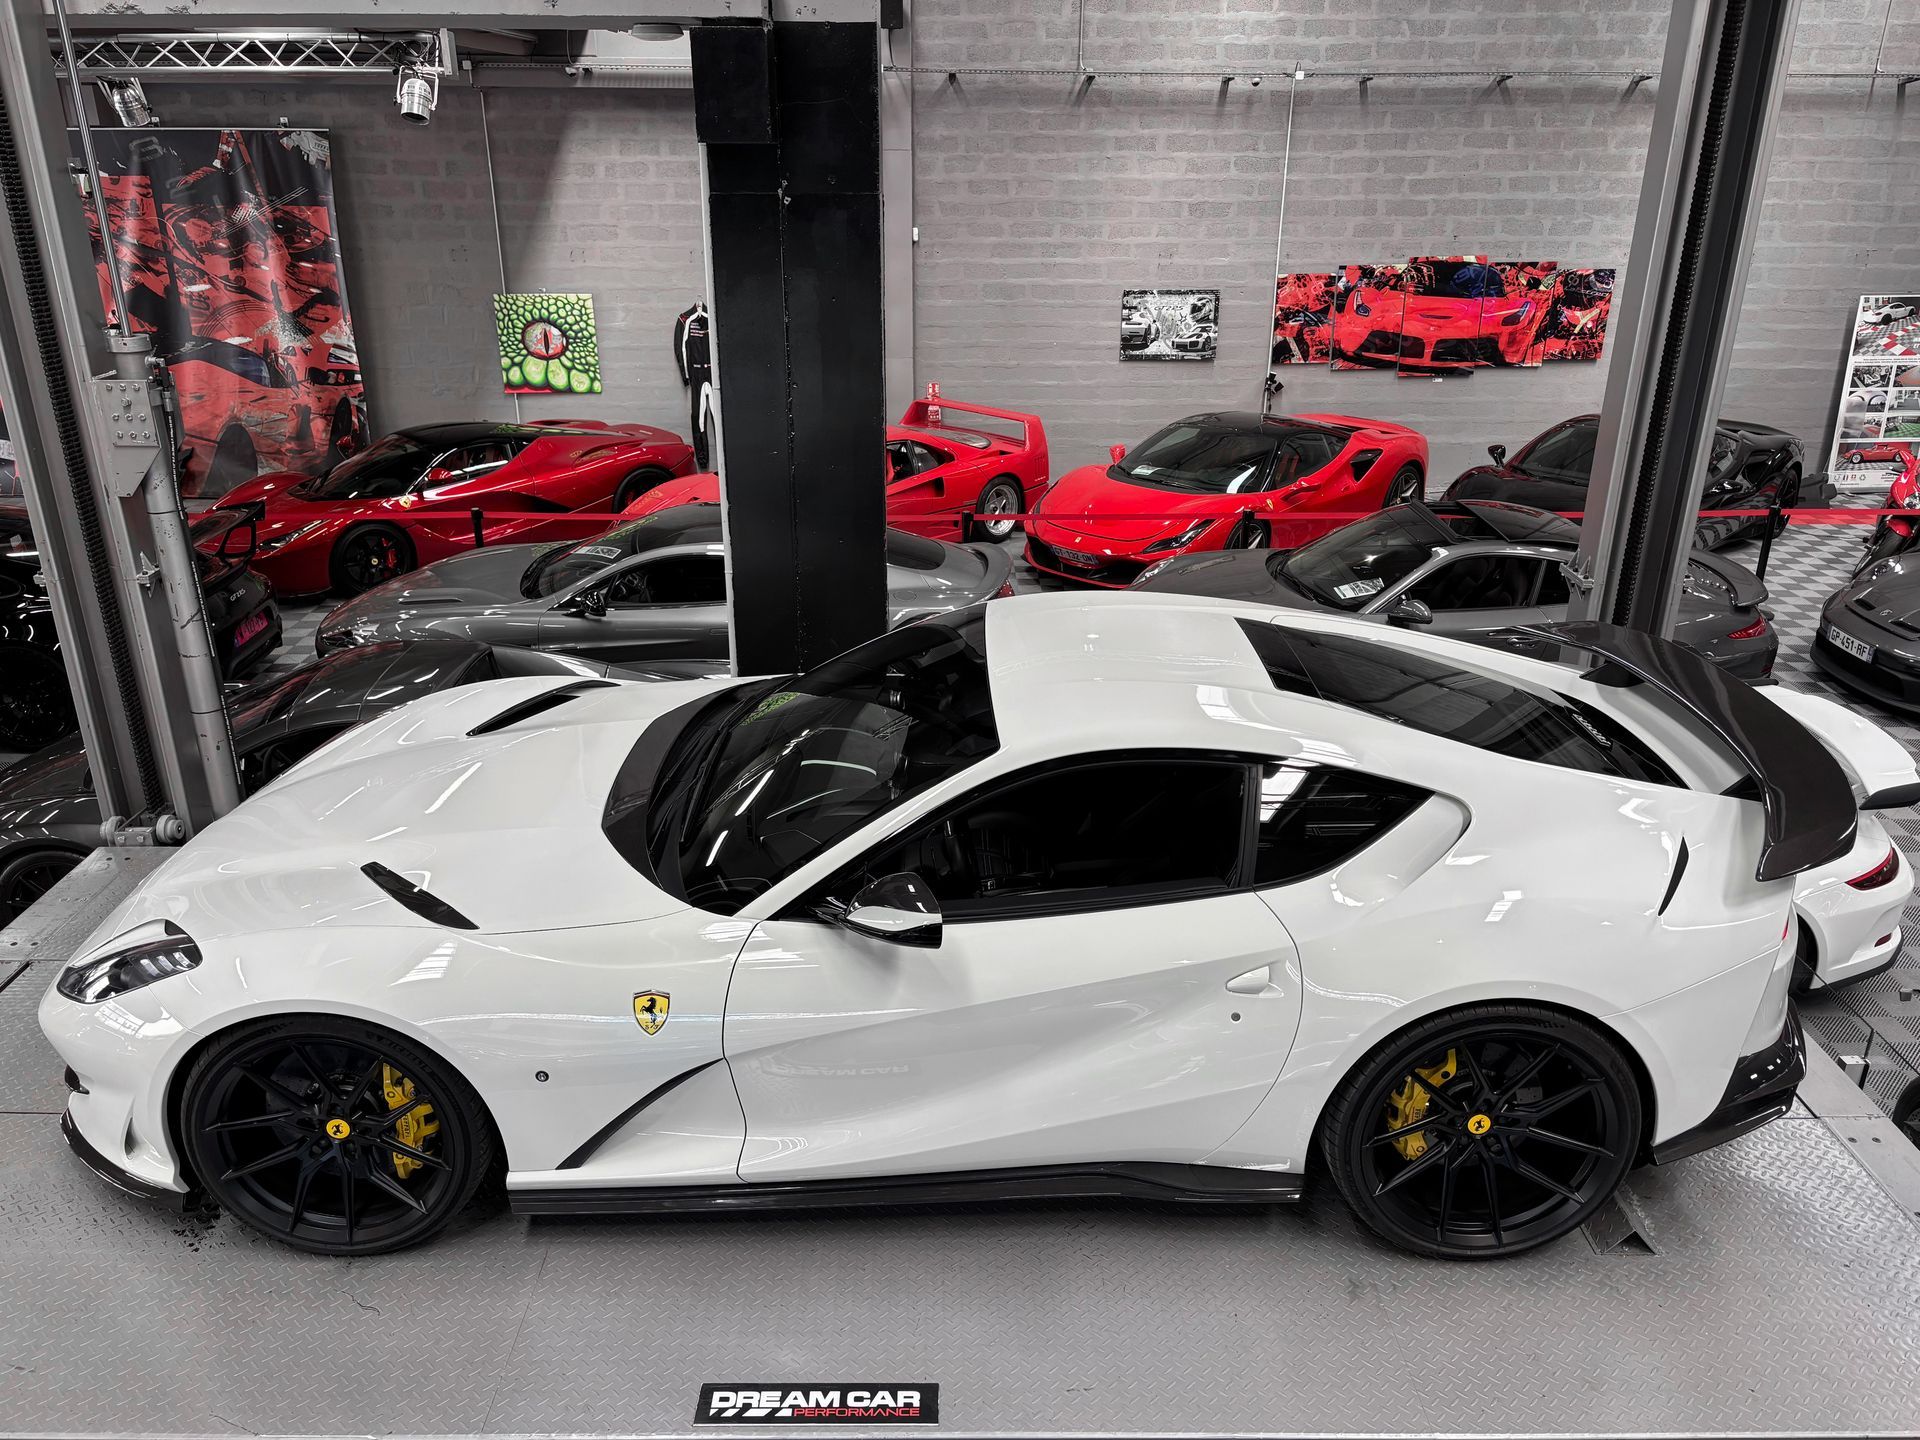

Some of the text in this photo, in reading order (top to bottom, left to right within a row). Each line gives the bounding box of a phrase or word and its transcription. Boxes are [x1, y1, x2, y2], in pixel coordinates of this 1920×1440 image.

[711, 1390, 921, 1408] DREAM CAR
[793, 1407, 920, 1417] PERFORMANCE
